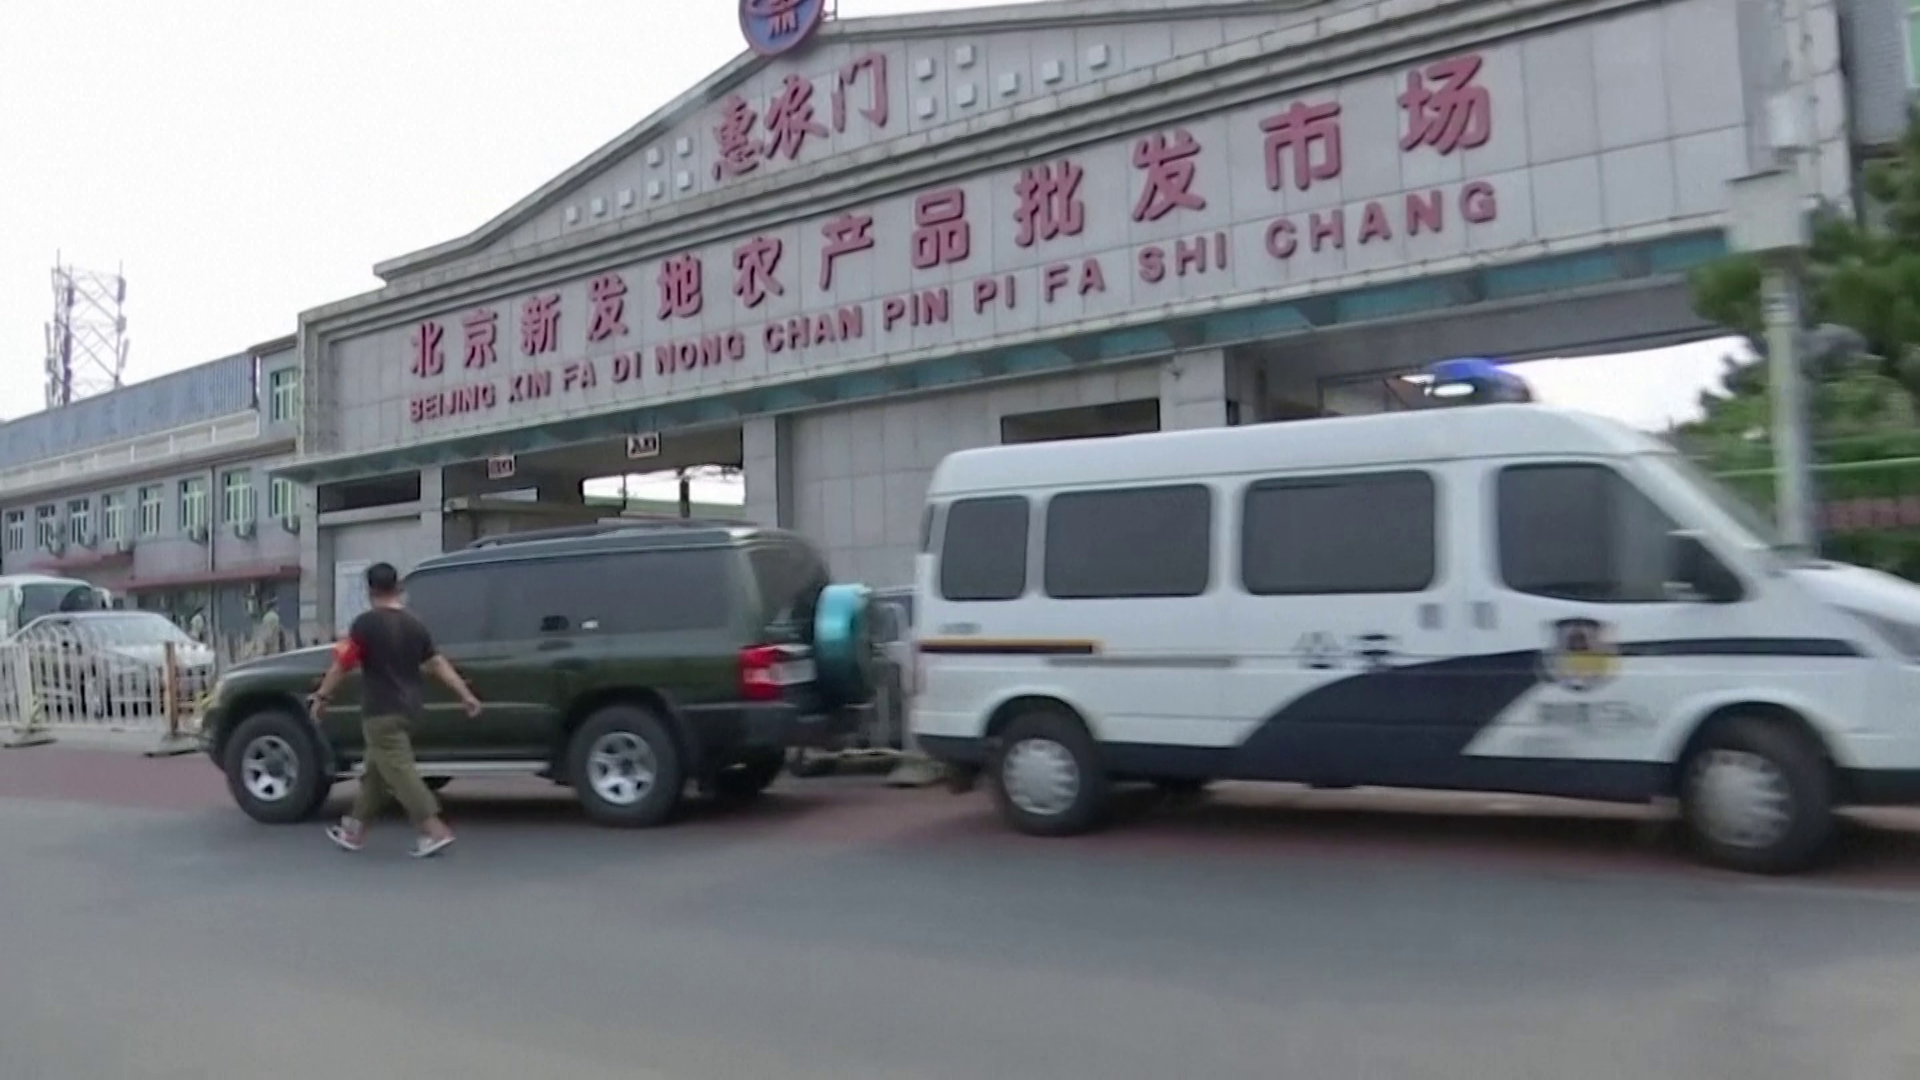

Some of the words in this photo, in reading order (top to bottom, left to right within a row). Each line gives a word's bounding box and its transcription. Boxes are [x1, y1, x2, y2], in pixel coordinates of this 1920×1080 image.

[410, 54, 1493, 378] 北京新发地农产品批发市场
[712, 53, 888, 181] 惠农门
[410, 383, 496, 423] BEIJING
[508, 369, 551, 403] XIN
[563, 361, 597, 391] FA
[612, 352, 642, 383] DI
[656, 332, 744, 375] NONG
[764, 306, 862, 352] CHAN
[885, 288, 949, 332] PIN
[974, 274, 1015, 313] PI
[1044, 259, 1105, 301] FA
[1138, 231, 1228, 283] SHI
[1265, 181, 1498, 259] CHANG
